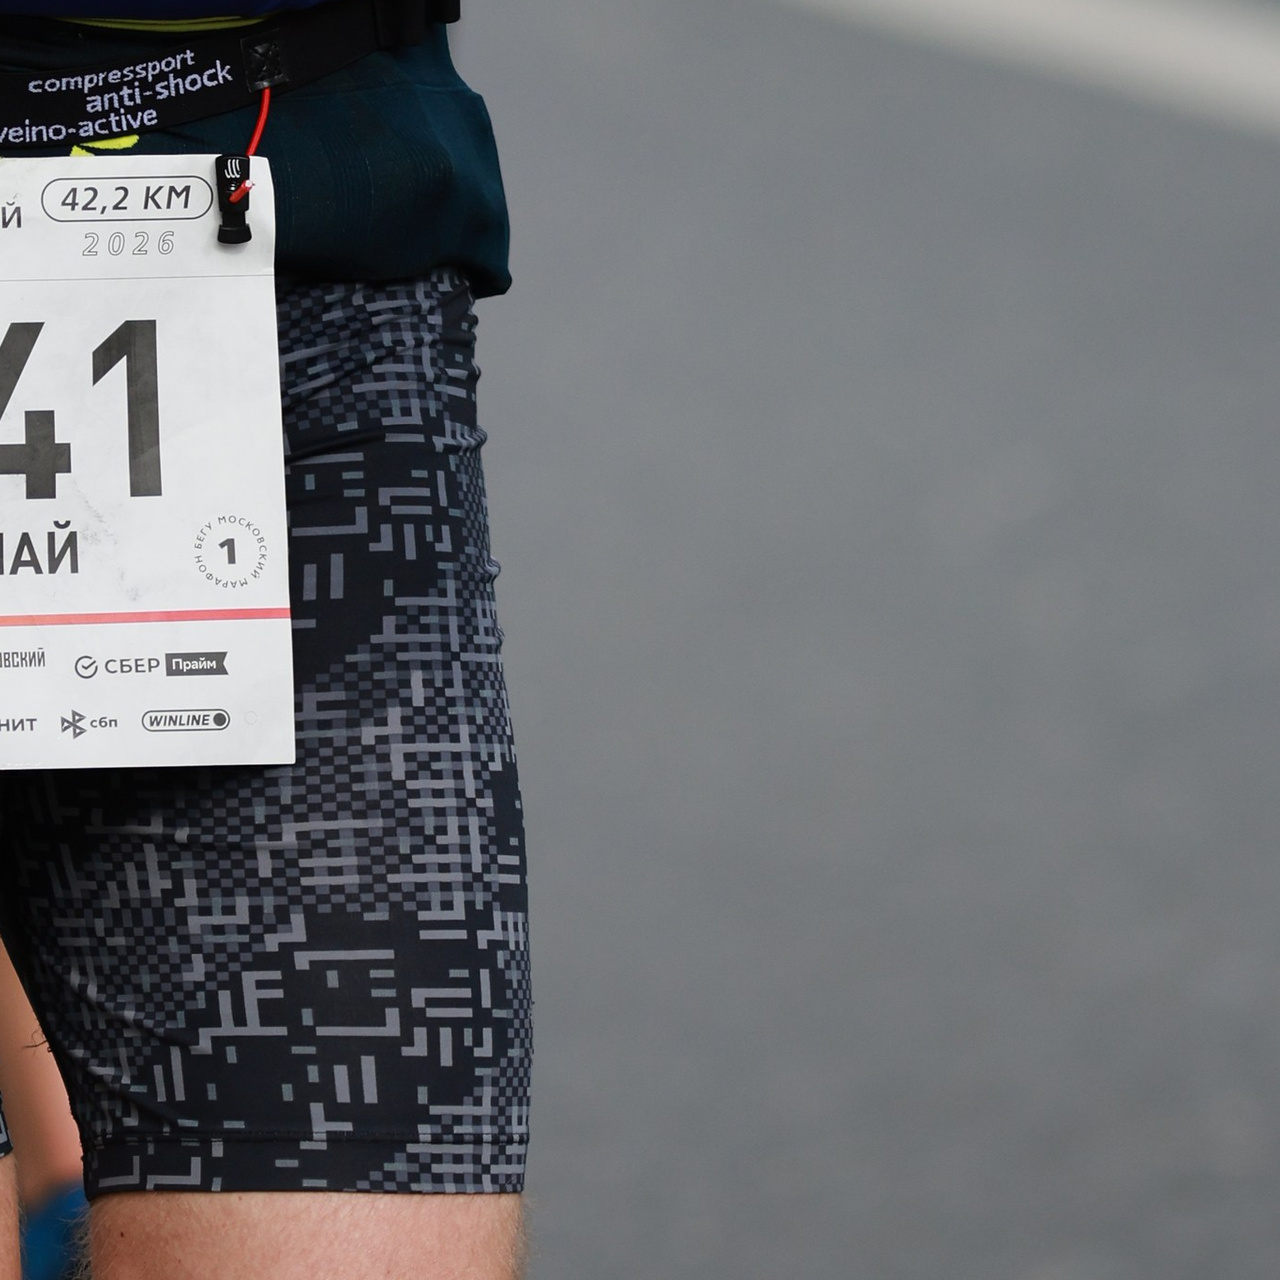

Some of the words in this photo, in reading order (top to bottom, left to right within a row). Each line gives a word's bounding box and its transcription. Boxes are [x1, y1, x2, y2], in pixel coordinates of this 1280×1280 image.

[27, 49, 195, 94] compressport
[85, 59, 233, 114] anti-shock
[60, 186, 130, 215] 42,2
[81, 231, 175, 256] 2026
[194, 522, 212, 550] БЕГУ
[217, 515, 268, 579] МОСКОВСКИЙ
[218, 538, 236, 565] 1
[194, 555, 248, 589] МАРАФОН
[104, 658, 160, 674] СБЕР
[171, 657, 217, 672] Прайм
[89, 716, 118, 729] сбп
[149, 714, 211, 727] WINLINE
